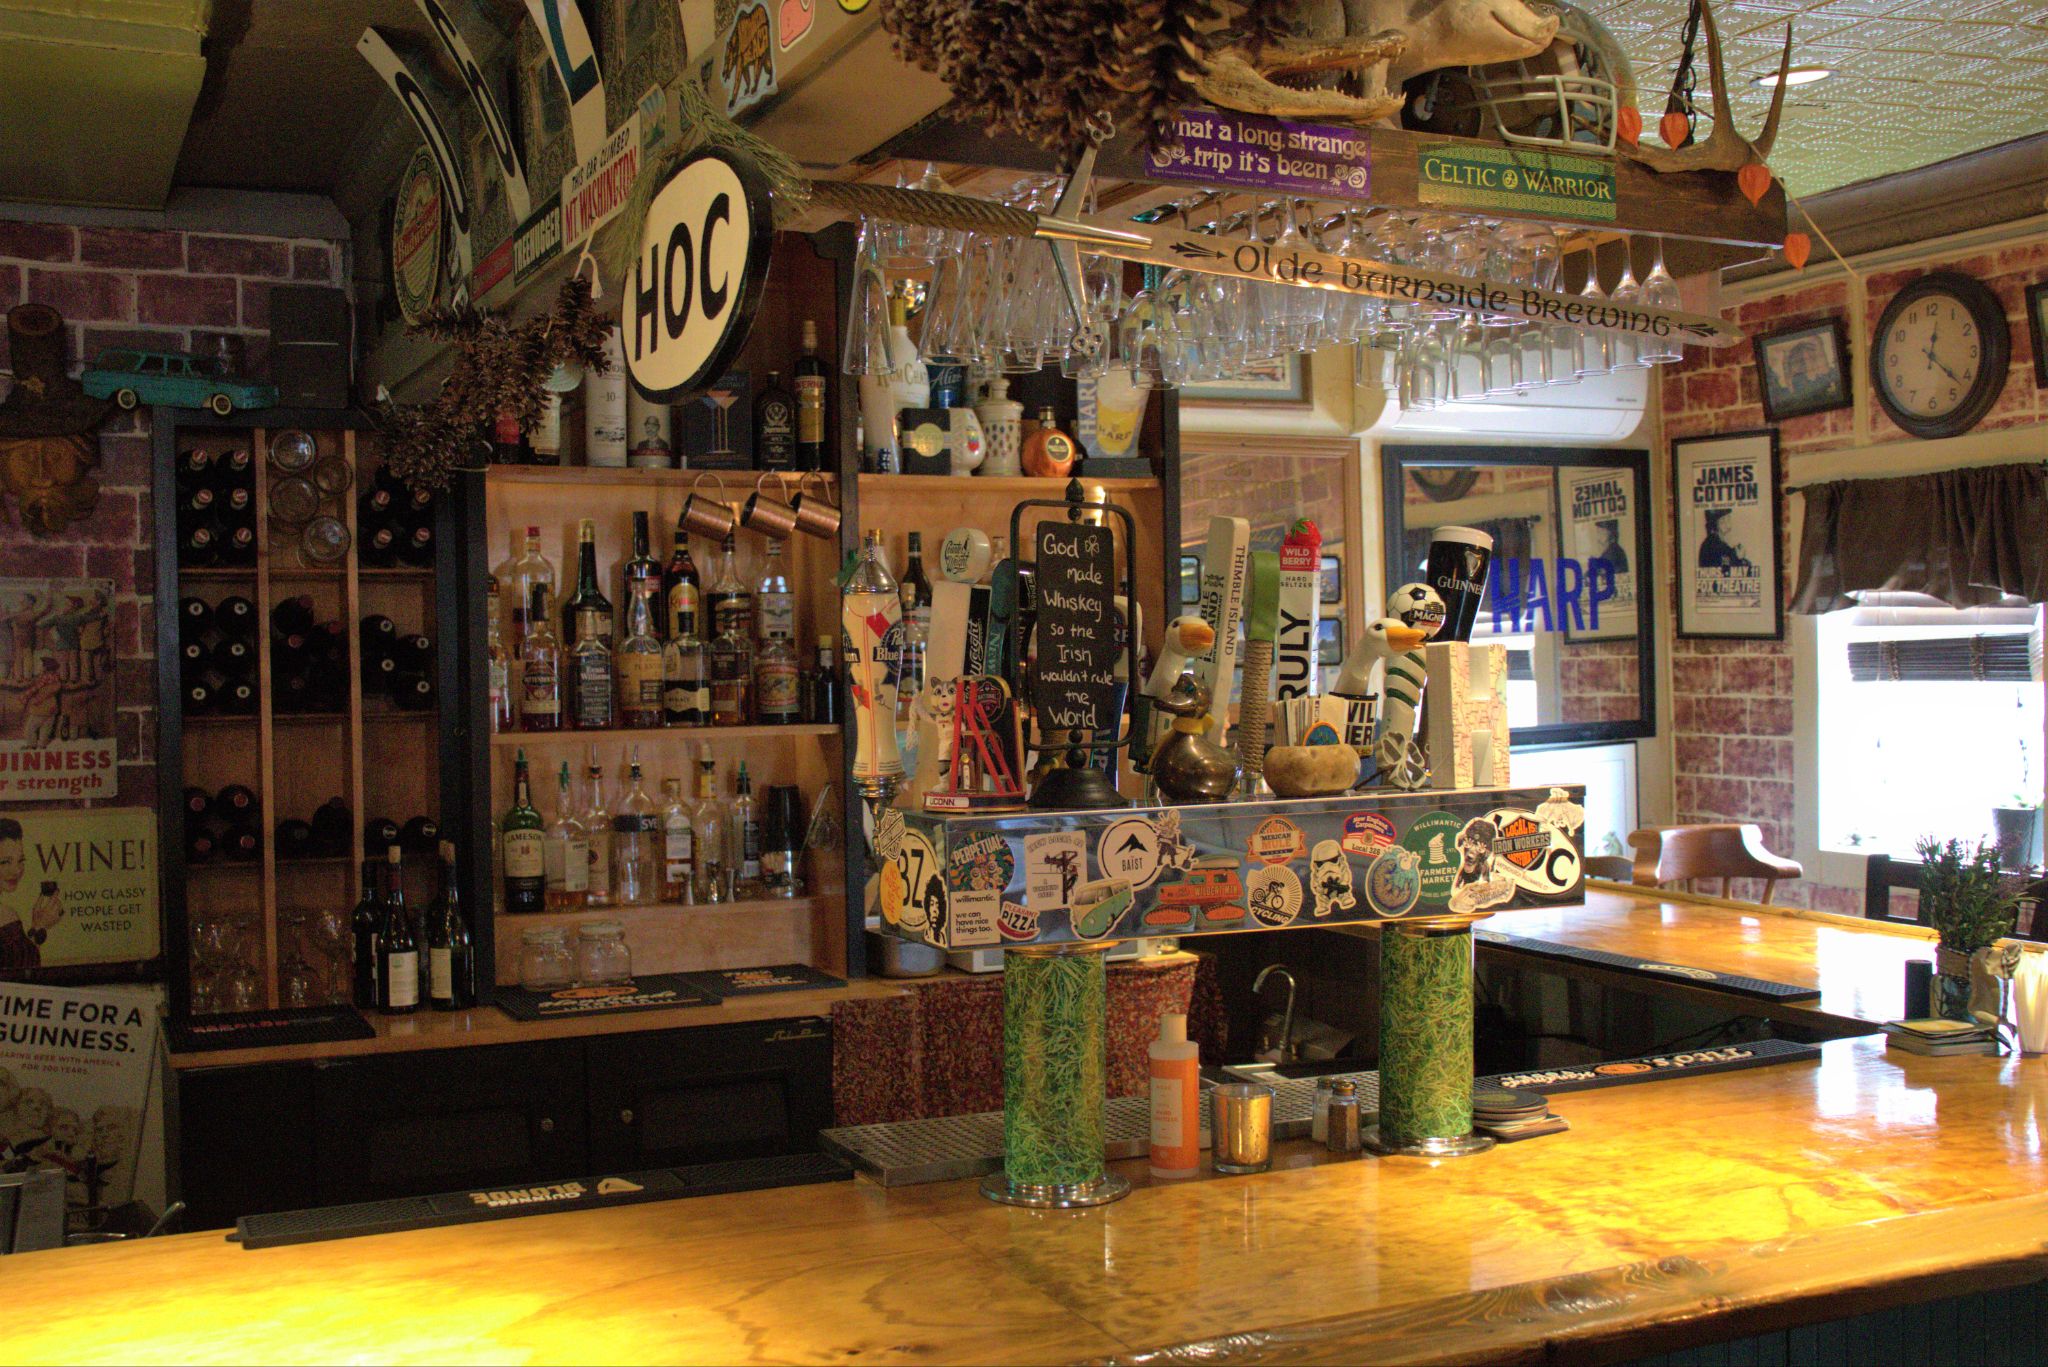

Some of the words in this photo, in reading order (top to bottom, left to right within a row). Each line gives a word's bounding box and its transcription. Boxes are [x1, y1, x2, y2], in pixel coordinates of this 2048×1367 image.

[1218, 125, 1232, 142] a
[1288, 132, 1367, 160] strange
[1193, 146, 1233, 173] trip
[1240, 152, 1271, 173] it's
[1277, 154, 1328, 180] been
[1424, 158, 1497, 188] CELTIC
[1522, 168, 1613, 201] WARRIOR
[1233, 244, 1324, 285] Olde
[634, 191, 730, 362] HOC
[1926, 302, 1939, 316] 12
[1951, 308, 1956, 320] 1
[1909, 312, 1918, 324] 11
[1895, 330, 1906, 342] 10
[1962, 323, 1972, 336] 2
[1970, 344, 1978, 358] 3
[1890, 354, 1898, 367] 9
[1895, 375, 1903, 388] 8
[1962, 369, 1972, 381] 4
[605, 391, 616, 402] 10
[1909, 390, 1917, 403] 7
[1928, 396, 1937, 409] 6
[1949, 388, 1957, 401] 5
[1697, 464, 1754, 485] JAMES
[1693, 482, 1758, 503] COTTON
[1043, 533, 1079, 559] God
[1285, 547, 1311, 557] WILD
[1282, 556, 1312, 566] BERRY
[1066, 566, 1104, 585] made
[1230, 545, 1246, 603] THIMBLE
[1490, 556, 1616, 634] HARP
[1695, 580, 1712, 594] FOX
[1716, 579, 1761, 595] THEATRE
[1043, 590, 1102, 623] Whiskey
[1050, 624, 1065, 636] so
[1070, 623, 1096, 640] the
[1224, 606, 1238, 656] ISLAND
[875, 646, 899, 662] Blue
[1056, 645, 1093, 667] Irish
[1277, 608, 1311, 701] RULY
[1040, 669, 1089, 684] wouldn't
[1090, 671, 1114, 685] rule
[1064, 690, 1090, 706] the
[1048, 706, 1099, 730] World
[17, 773, 103, 795] strength
[929, 797, 955, 807] UCONN
[1355, 821, 1385, 834] Carpenters
[1366, 815, 1389, 831] England
[1413, 818, 1462, 832] WILLIMANTIC
[1504, 817, 1527, 837] LOCAL
[506, 828, 542, 843] JAMESON
[1493, 839, 1514, 853] IRON
[1514, 833, 1551, 850] WORKERS
[951, 834, 1005, 867] PERPETUAL
[1351, 843, 1368, 853] Local
[35, 839, 146, 874] WINE!
[1420, 866, 1458, 877] FARMERS
[1422, 875, 1457, 885] MARKET
[64, 888, 97, 900] HOW
[101, 887, 147, 900] CLASSY
[70, 904, 114, 918] PEOPLE
[118, 903, 142, 916] GET
[955, 911, 967, 919] we
[968, 910, 982, 918] can
[1004, 902, 1040, 919] PLEASANT
[1251, 905, 1290, 924] CYCLING
[80, 919, 132, 933] WASTED
[955, 919, 975, 928] have
[975, 917, 989, 926] nice
[1001, 909, 1037, 932] PIZZA
[955, 925, 979, 936] things
[978, 925, 993, 933] too.
[0, 995, 53, 1020] IME
[61, 1001, 119, 1026] FOR
[124, 1007, 143, 1028] A
[58, 1055, 81, 1064] WITH
[83, 1057, 121, 1067] AMERICA
[468, 1180, 588, 1205] BLONDE
